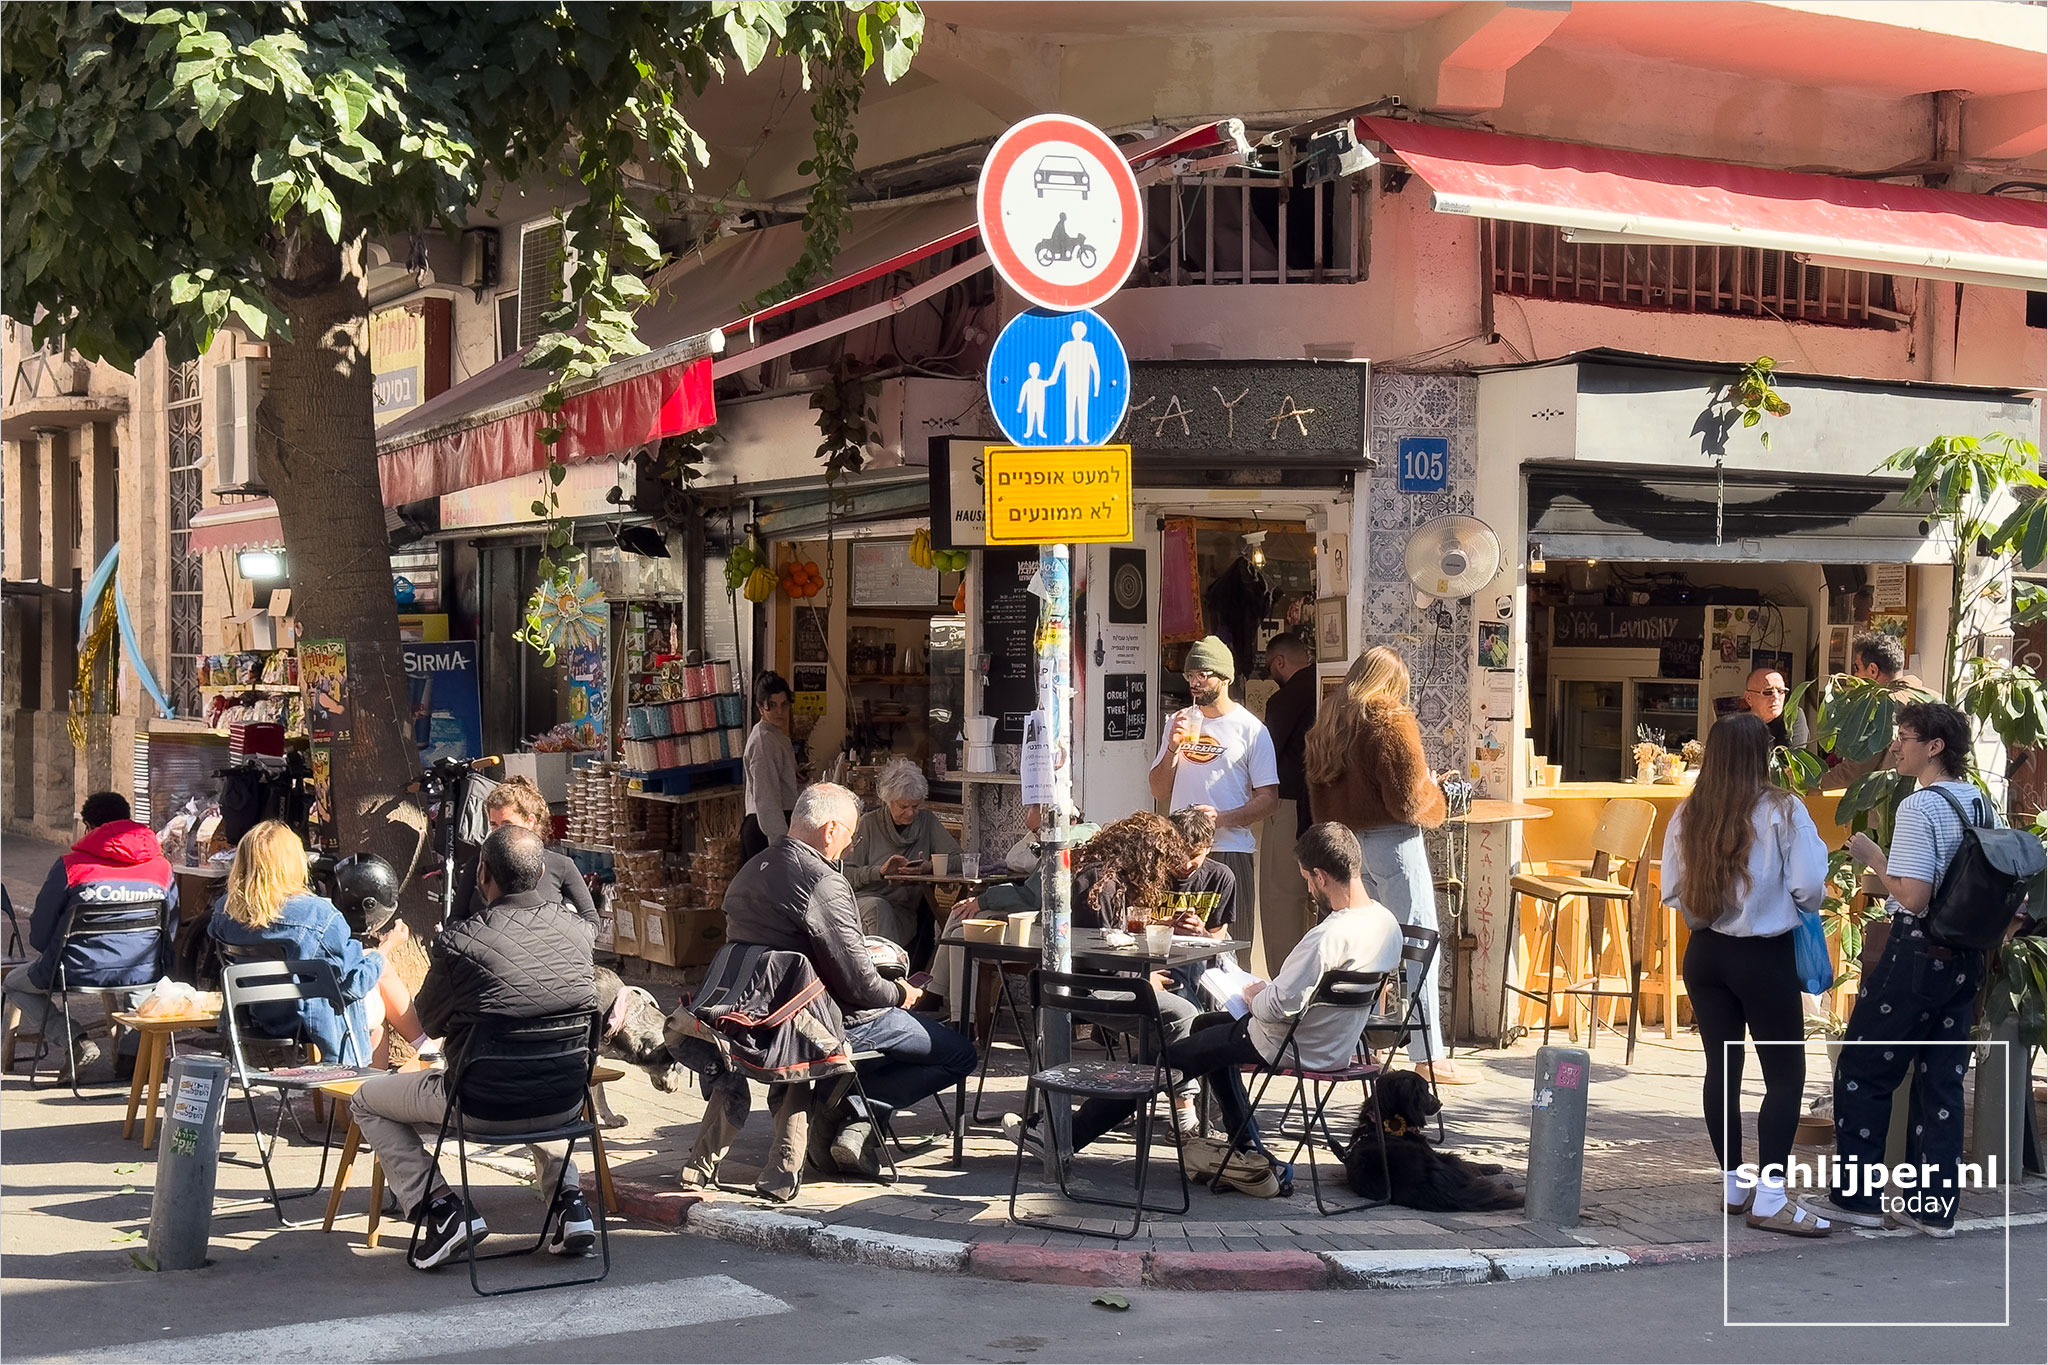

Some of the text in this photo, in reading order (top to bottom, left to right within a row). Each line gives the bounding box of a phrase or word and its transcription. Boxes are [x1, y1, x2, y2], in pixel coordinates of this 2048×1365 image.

[1403, 451, 1444, 482] 105
[998, 466, 1120, 486] למעט אופניים
[1009, 501, 1112, 523] לא ממונעים
[403, 651, 471, 673] SIRMA
[1131, 682, 1144, 693] PICK
[1106, 691, 1126, 700] ORDER
[1106, 705, 1126, 715] THERE
[1131, 699, 1142, 710] UP
[1128, 714, 1145, 725] HERE
